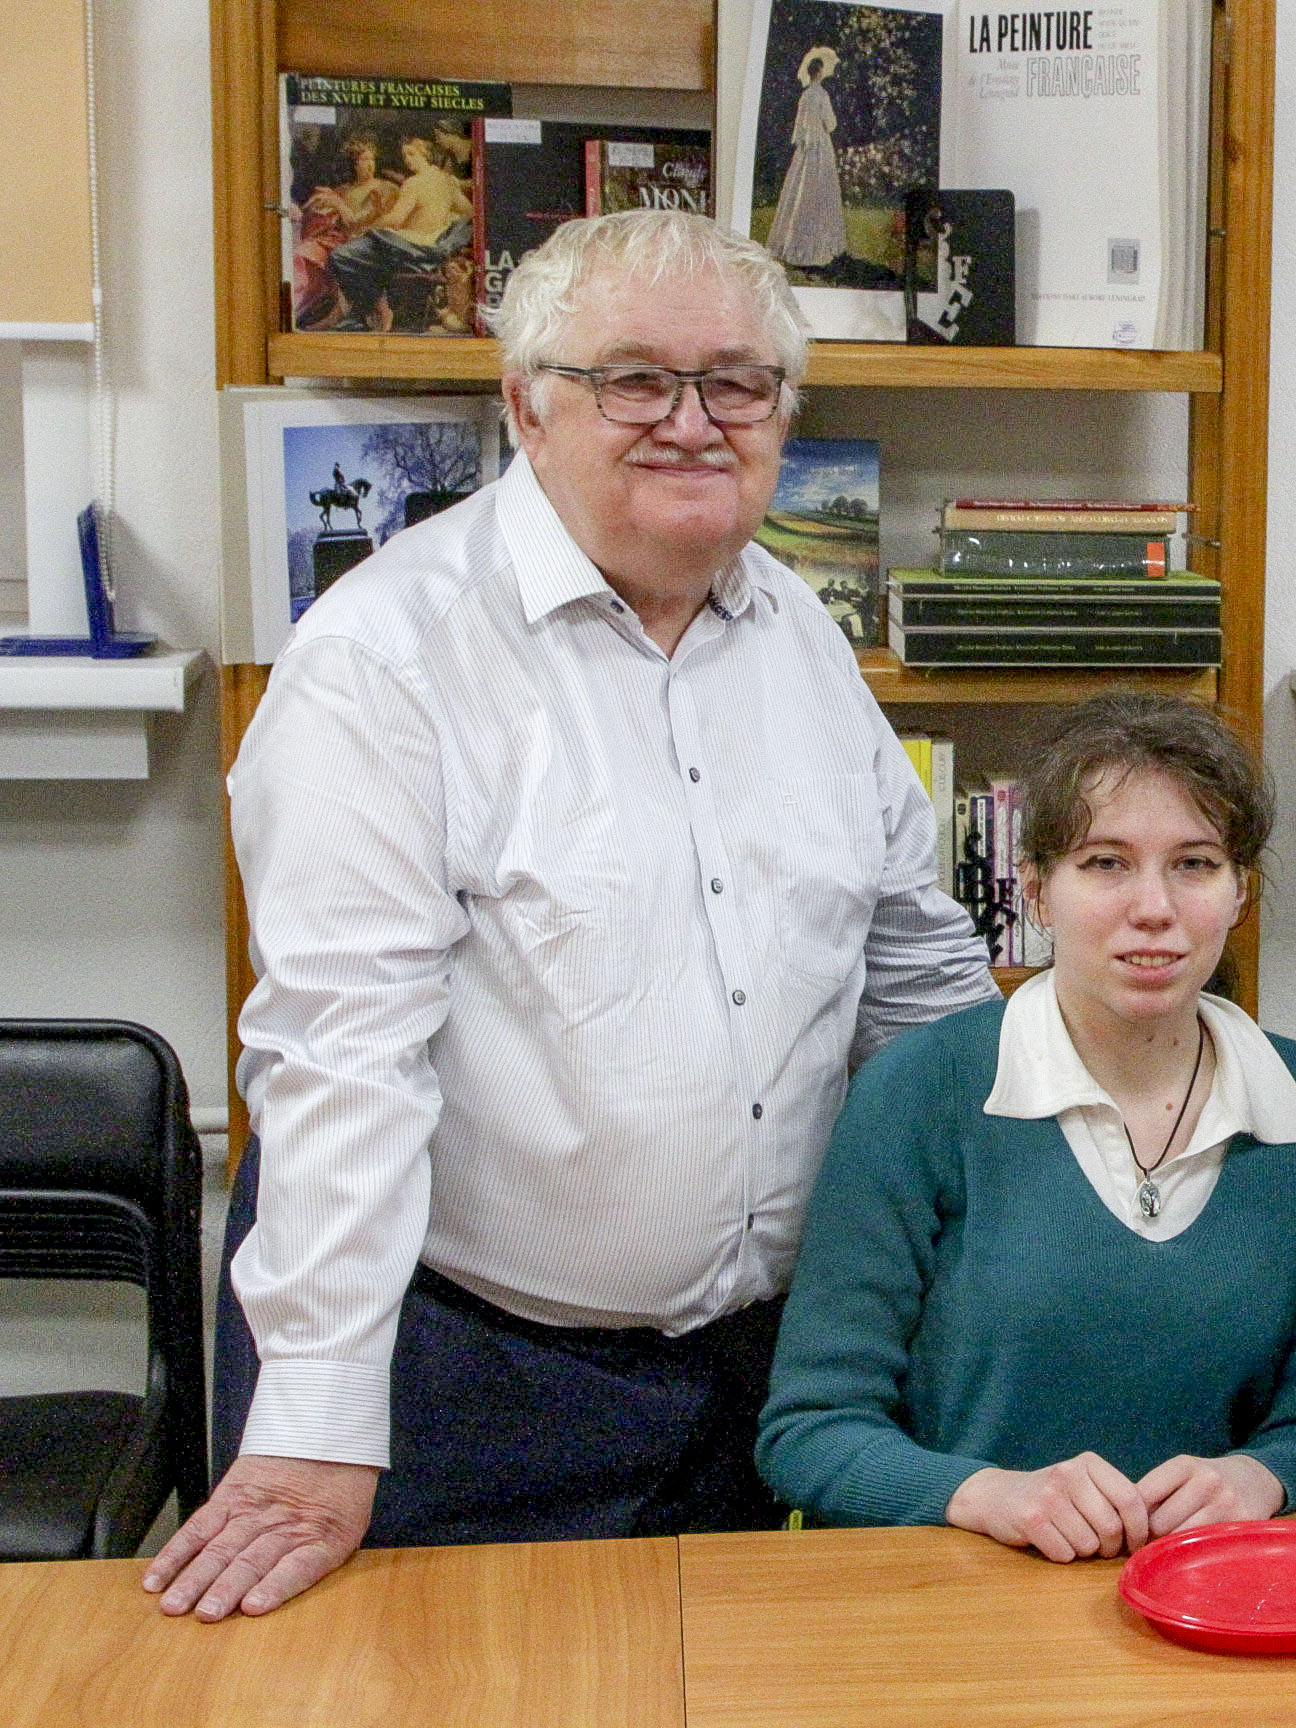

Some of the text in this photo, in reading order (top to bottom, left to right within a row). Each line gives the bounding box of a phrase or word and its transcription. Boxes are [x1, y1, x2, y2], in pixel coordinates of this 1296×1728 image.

[968, 15, 991, 53] LA
[997, 11, 1093, 52] PEINTURE
[1026, 54, 1141, 99] FRANÇAISE
[300, 91, 327, 103] DES
[369, 94, 385, 107] ET
